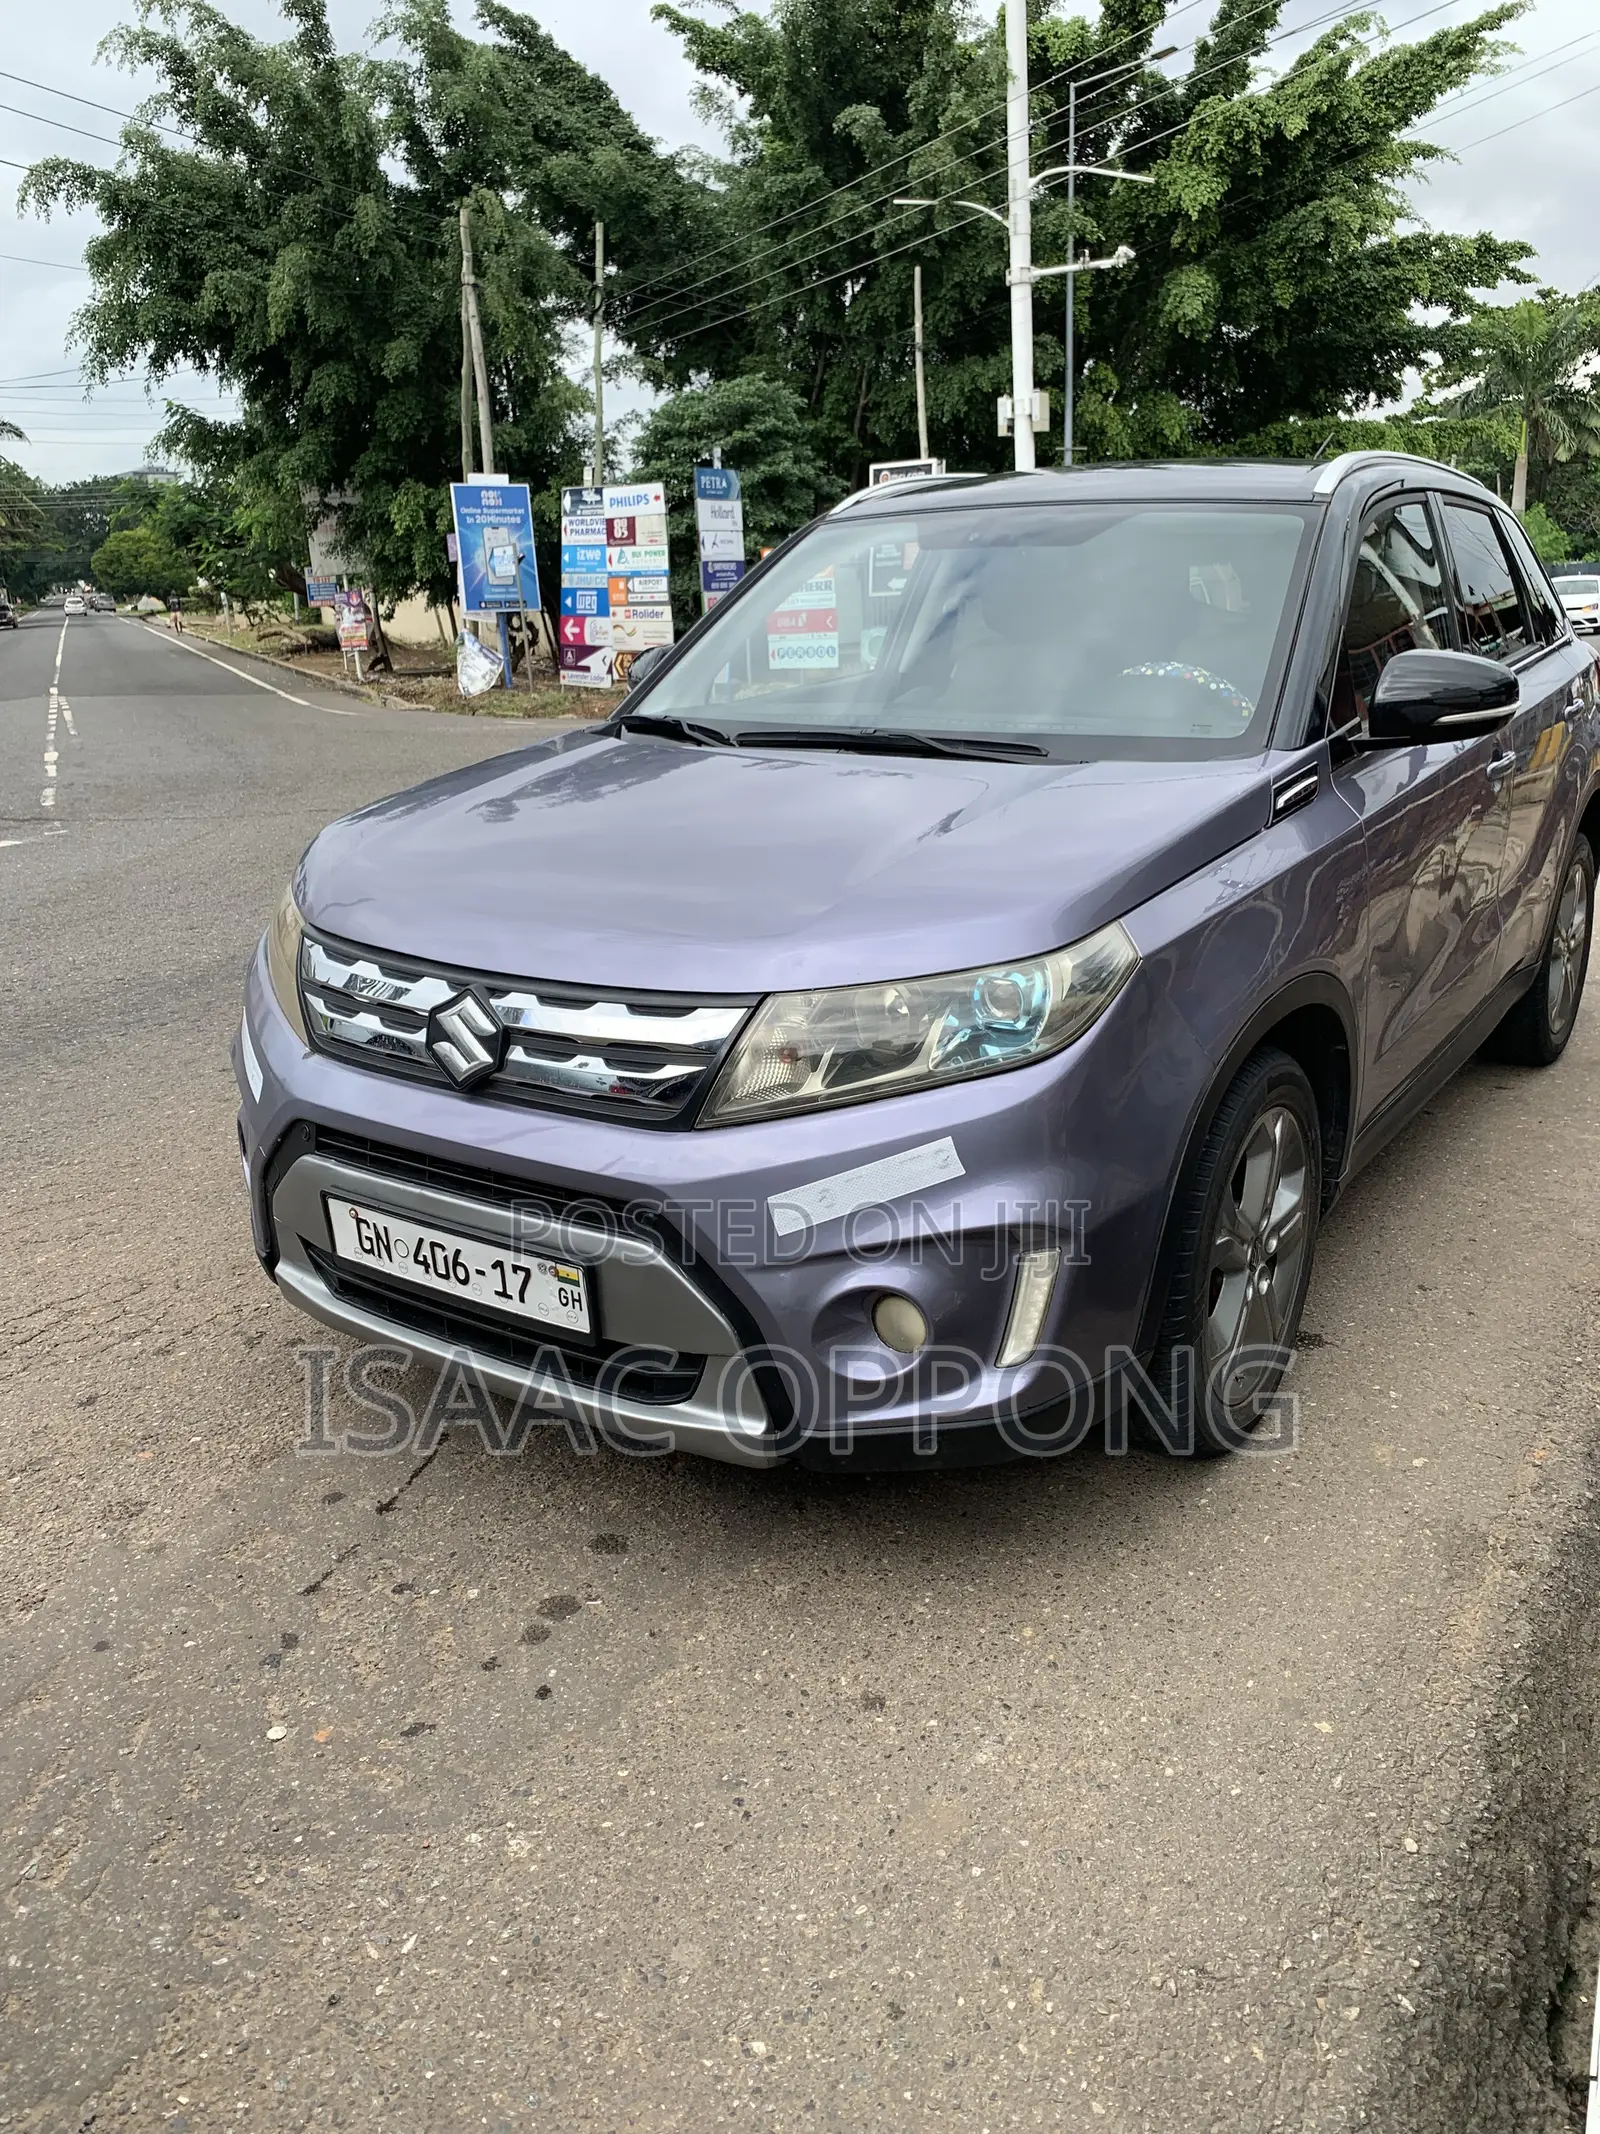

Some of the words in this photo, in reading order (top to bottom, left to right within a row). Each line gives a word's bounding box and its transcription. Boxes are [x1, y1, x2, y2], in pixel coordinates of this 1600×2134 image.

[700, 476, 728, 489] PETRA
[609, 493, 650, 508] PHILIPS
[482, 507, 525, 515] Supermarket
[710, 504, 736, 519] Hollard
[568, 517, 606, 527] WORLDVIE
[569, 528, 607, 537] PHARMAC
[576, 547, 602, 561] izwe
[644, 549, 666, 558] POWER
[632, 609, 664, 619] Rolider
[777, 645, 837, 660] PERSOL
[567, 671, 590, 680] Lavender
[590, 673, 606, 682] Lodge
[355, 1217, 394, 1263] GN
[412, 1237, 532, 1304] 406-17
[558, 1286, 584, 1312] GH
